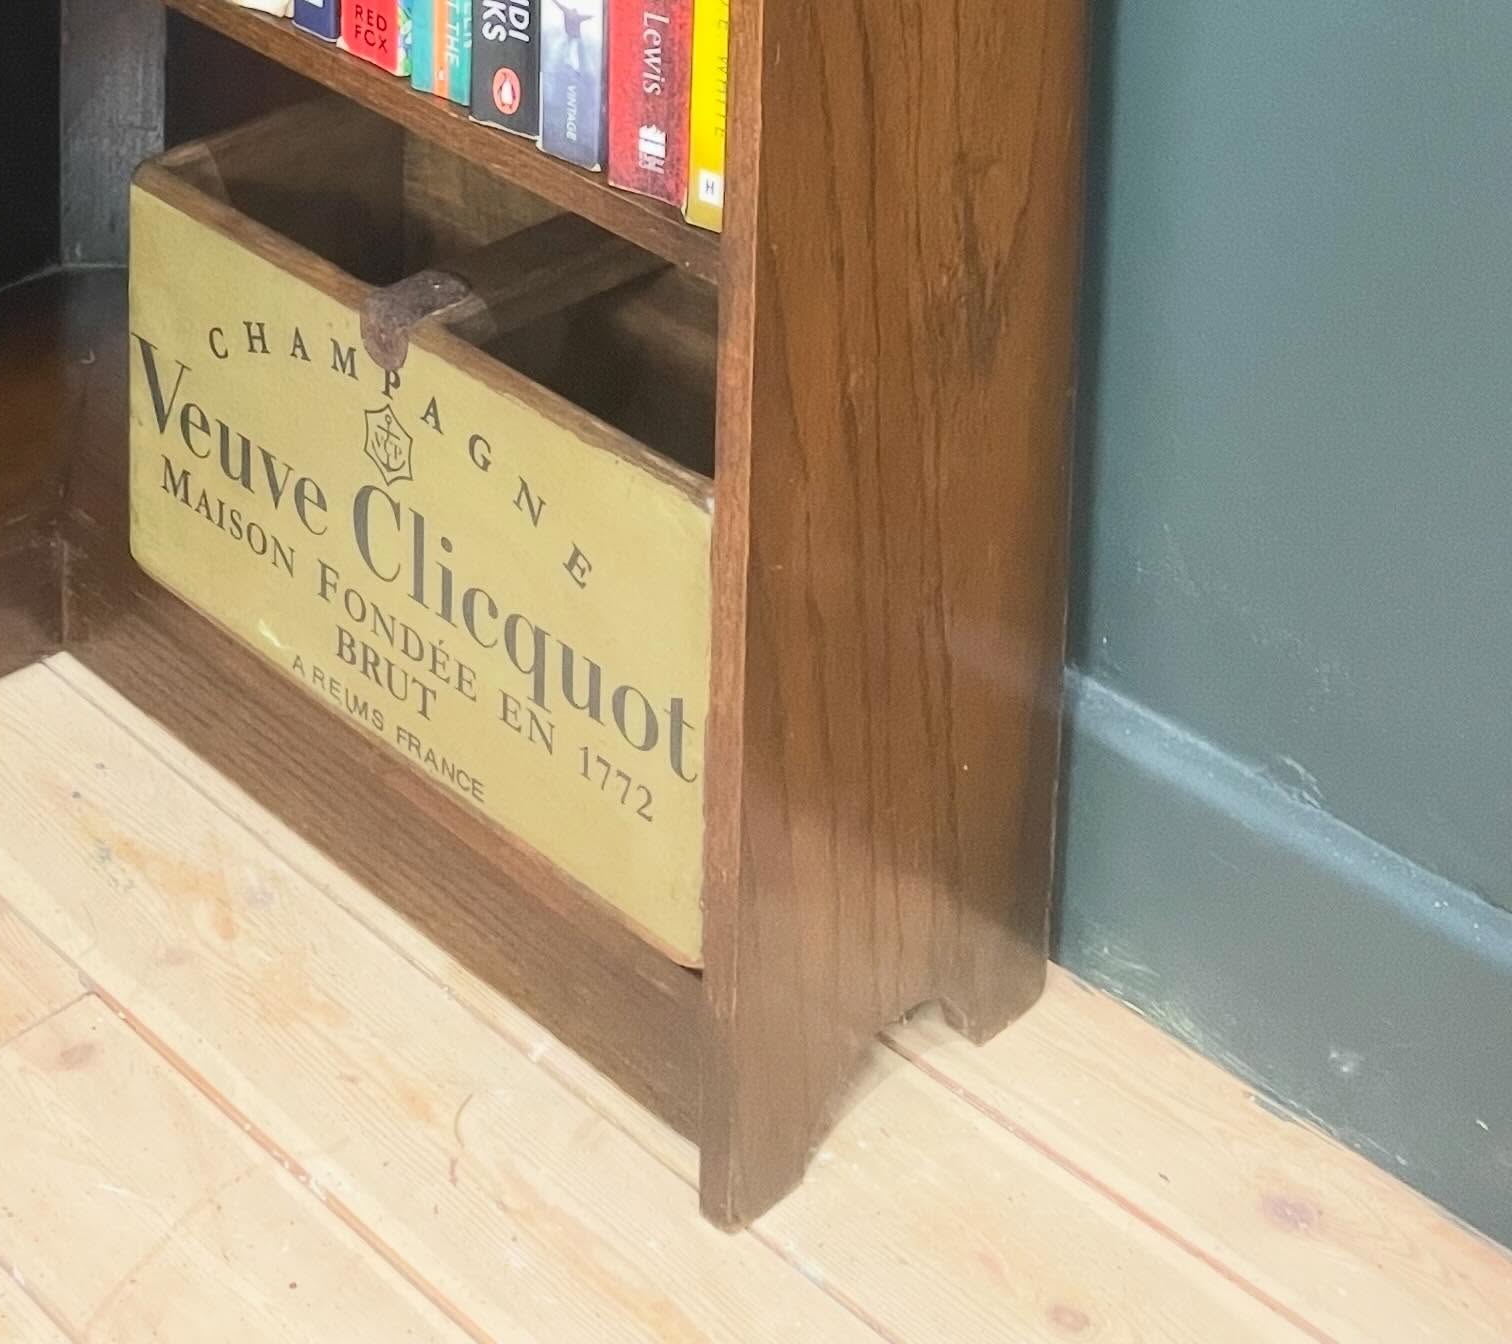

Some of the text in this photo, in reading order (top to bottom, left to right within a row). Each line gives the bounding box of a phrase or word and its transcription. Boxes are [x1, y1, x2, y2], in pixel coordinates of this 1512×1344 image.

[354, 4, 388, 32] RED
[443, 23, 460, 67] THE
[642, 11, 672, 97] Lewis
[565, 84, 578, 143] VINTAGE
[207, 321, 594, 589] CHAMPAGNE
[131, 332, 699, 784] Veuve Clicquot
[161, 454, 654, 823] MAISON FONDÉE EN 1772
[335, 624, 438, 721] BRUT
[291, 655, 486, 804] A REIMS FRANCE
